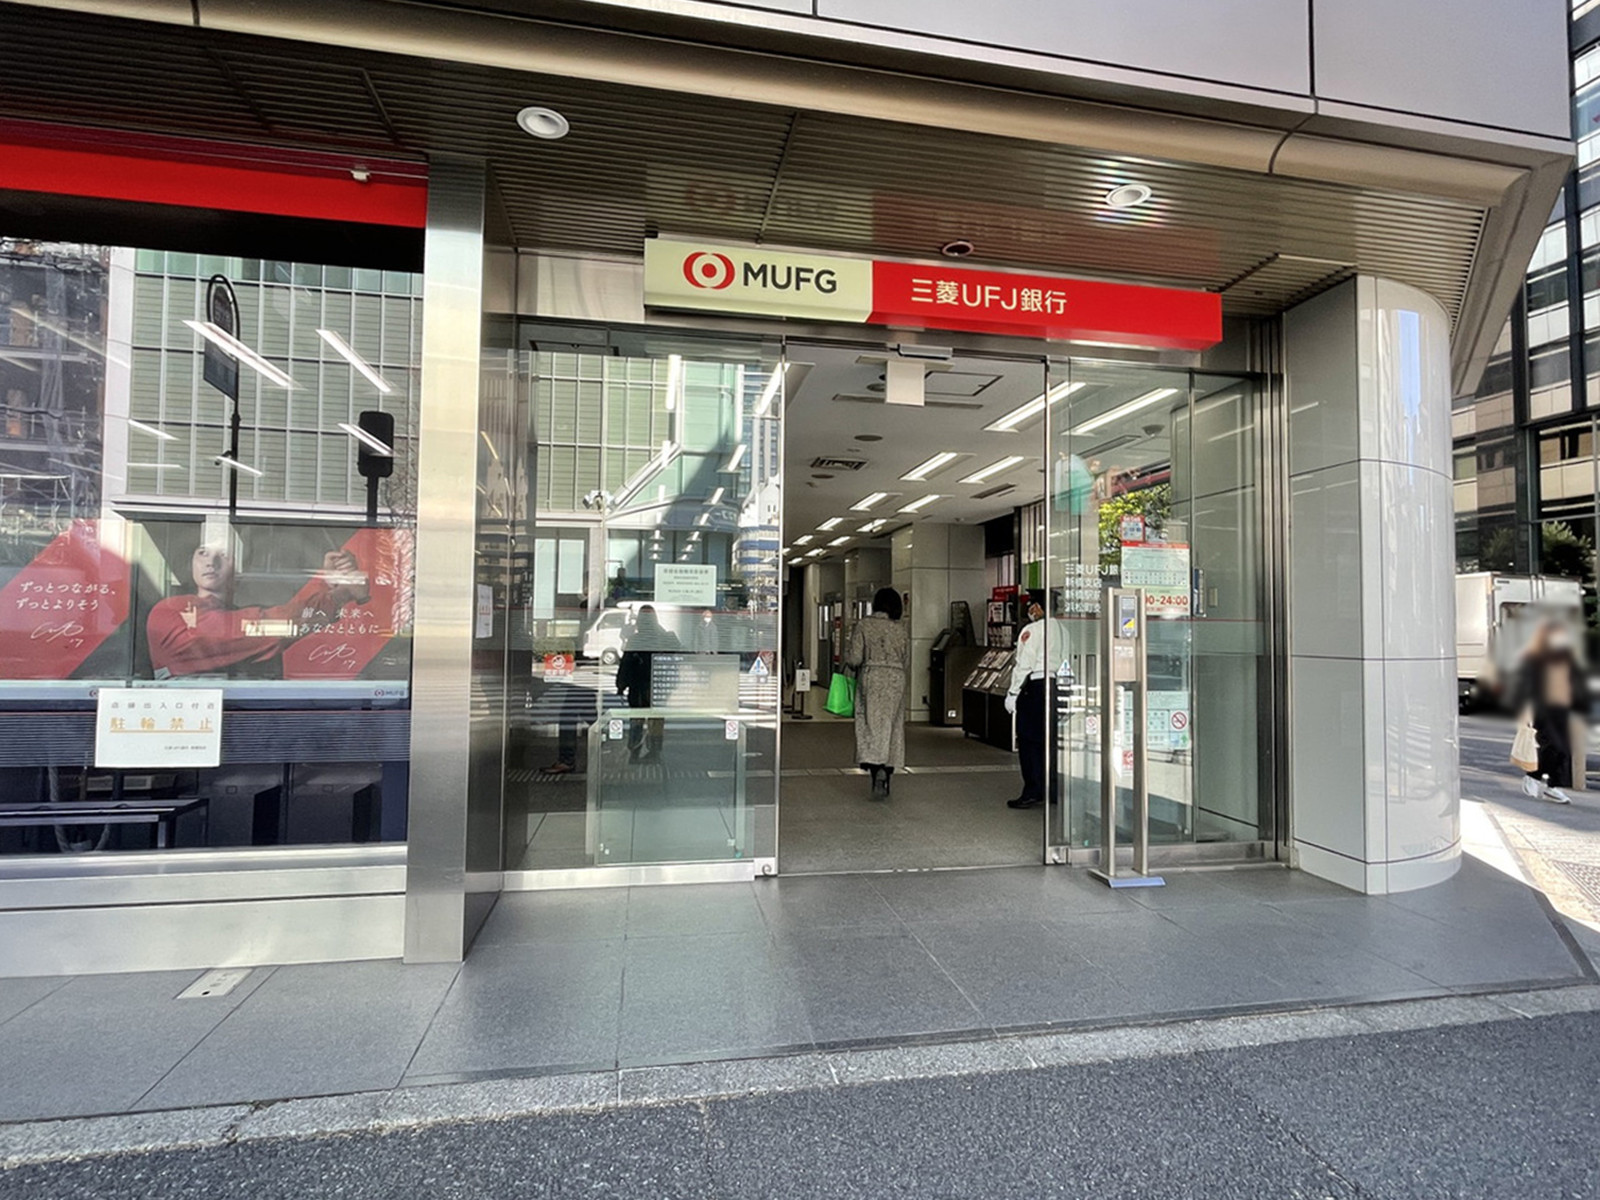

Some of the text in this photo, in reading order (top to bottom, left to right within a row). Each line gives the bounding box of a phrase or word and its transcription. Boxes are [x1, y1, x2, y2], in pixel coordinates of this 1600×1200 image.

[742, 262, 837, 293] MUFG
[910, 278, 1068, 315] 三菱UFJ銀行
[20, 581, 116, 595] ずっとつながる、
[16, 597, 99, 611] ずっとよりそう
[302, 607, 375, 618] 前へ 未来へ
[300, 623, 380, 635] あなたとともに
[109, 717, 213, 731] 駐輪禁止
